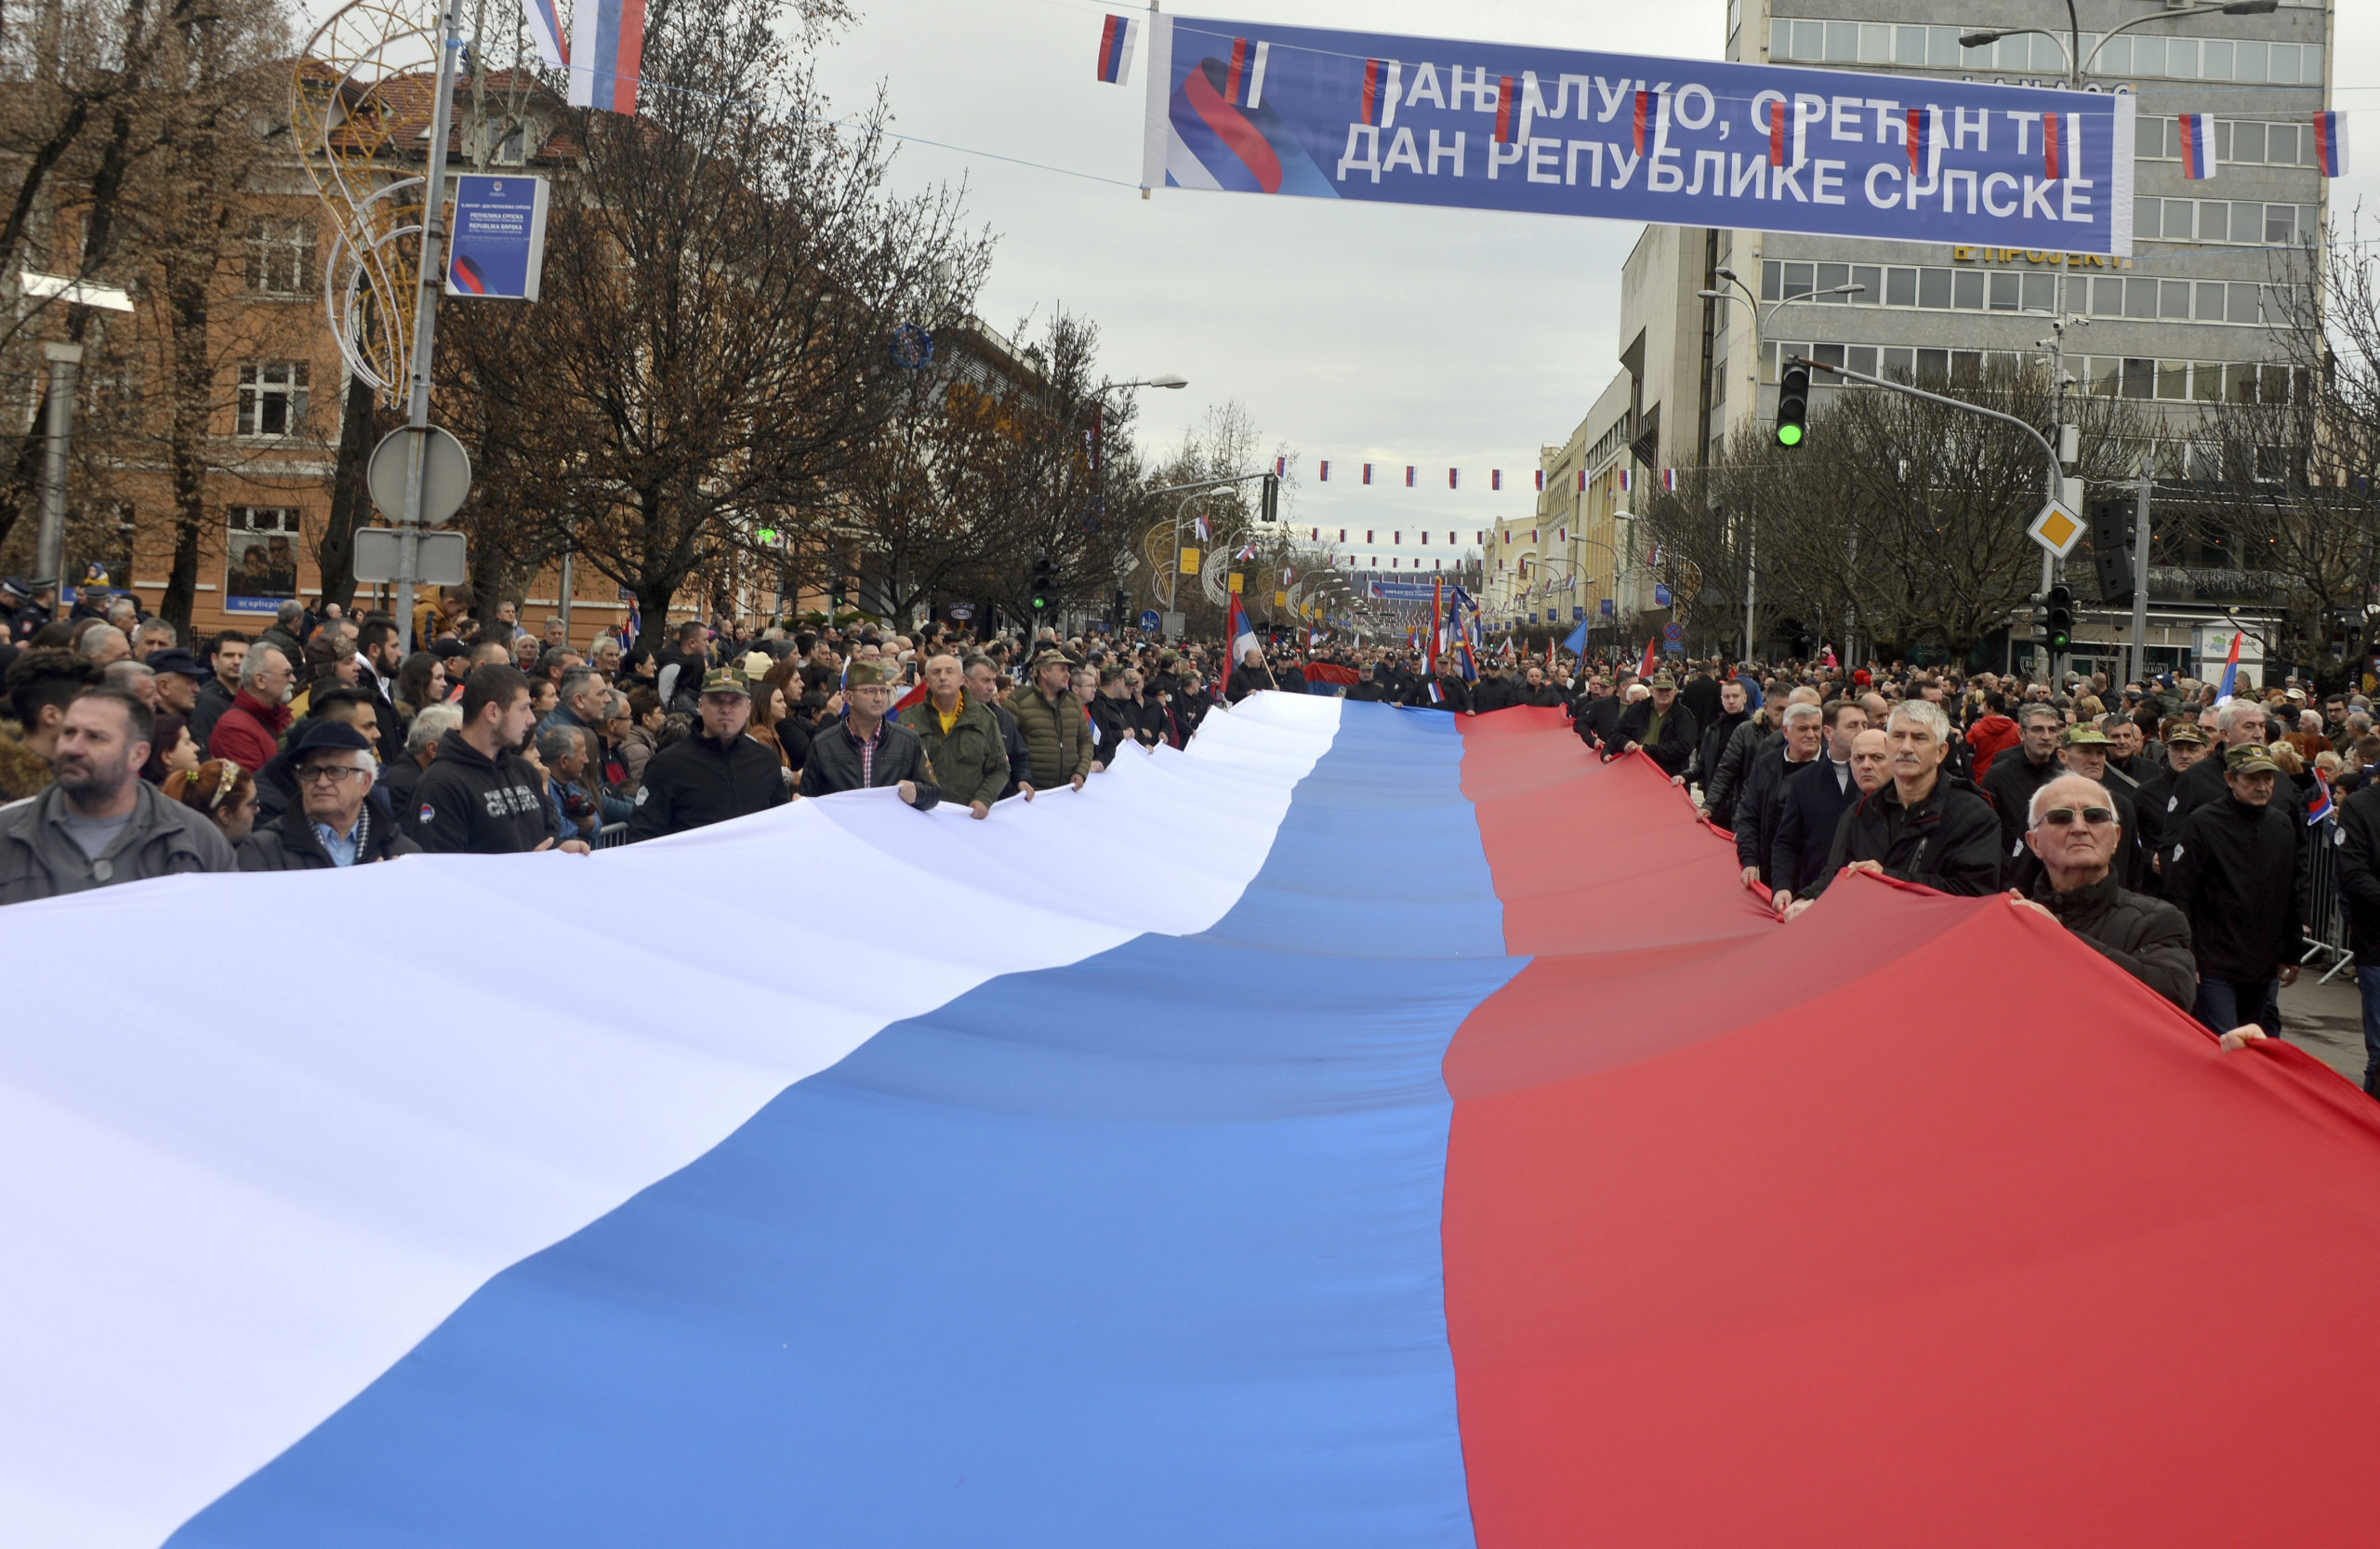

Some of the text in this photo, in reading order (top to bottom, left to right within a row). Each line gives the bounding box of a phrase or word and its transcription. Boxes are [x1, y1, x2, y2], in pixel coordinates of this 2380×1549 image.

[1368, 60, 1731, 141] АЊЛУО,
[2006, 110, 2069, 157] Т
[1336, 123, 2095, 224] ДАН РЕПУБЛИКЕ СРПСКЕ
[248, 601, 281, 609] opticplu
